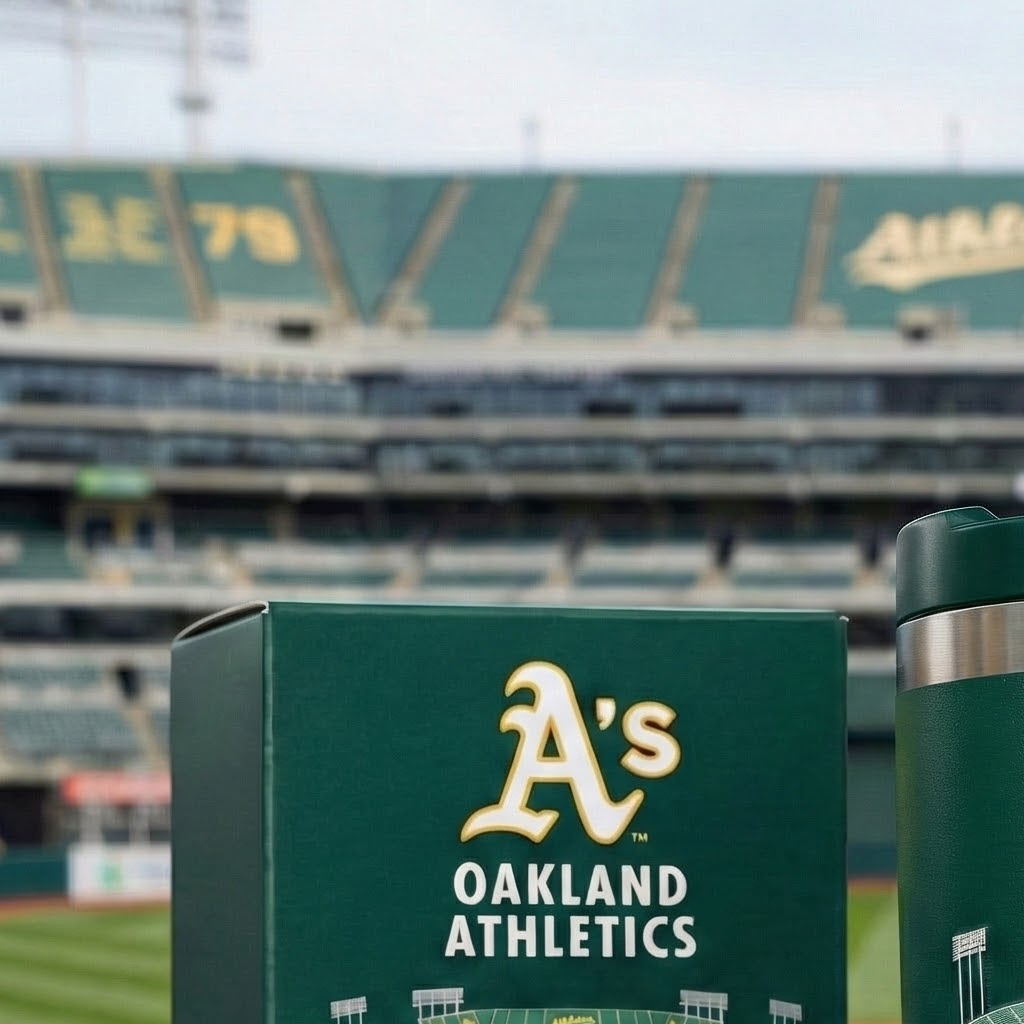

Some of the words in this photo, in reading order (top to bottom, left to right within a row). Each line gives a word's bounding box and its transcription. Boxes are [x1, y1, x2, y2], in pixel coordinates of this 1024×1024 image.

[460, 661, 682, 845] A's
[632, 832, 648, 843] TM
[453, 861, 687, 906] OAKLAND
[444, 914, 697, 959] ATHLETICS
